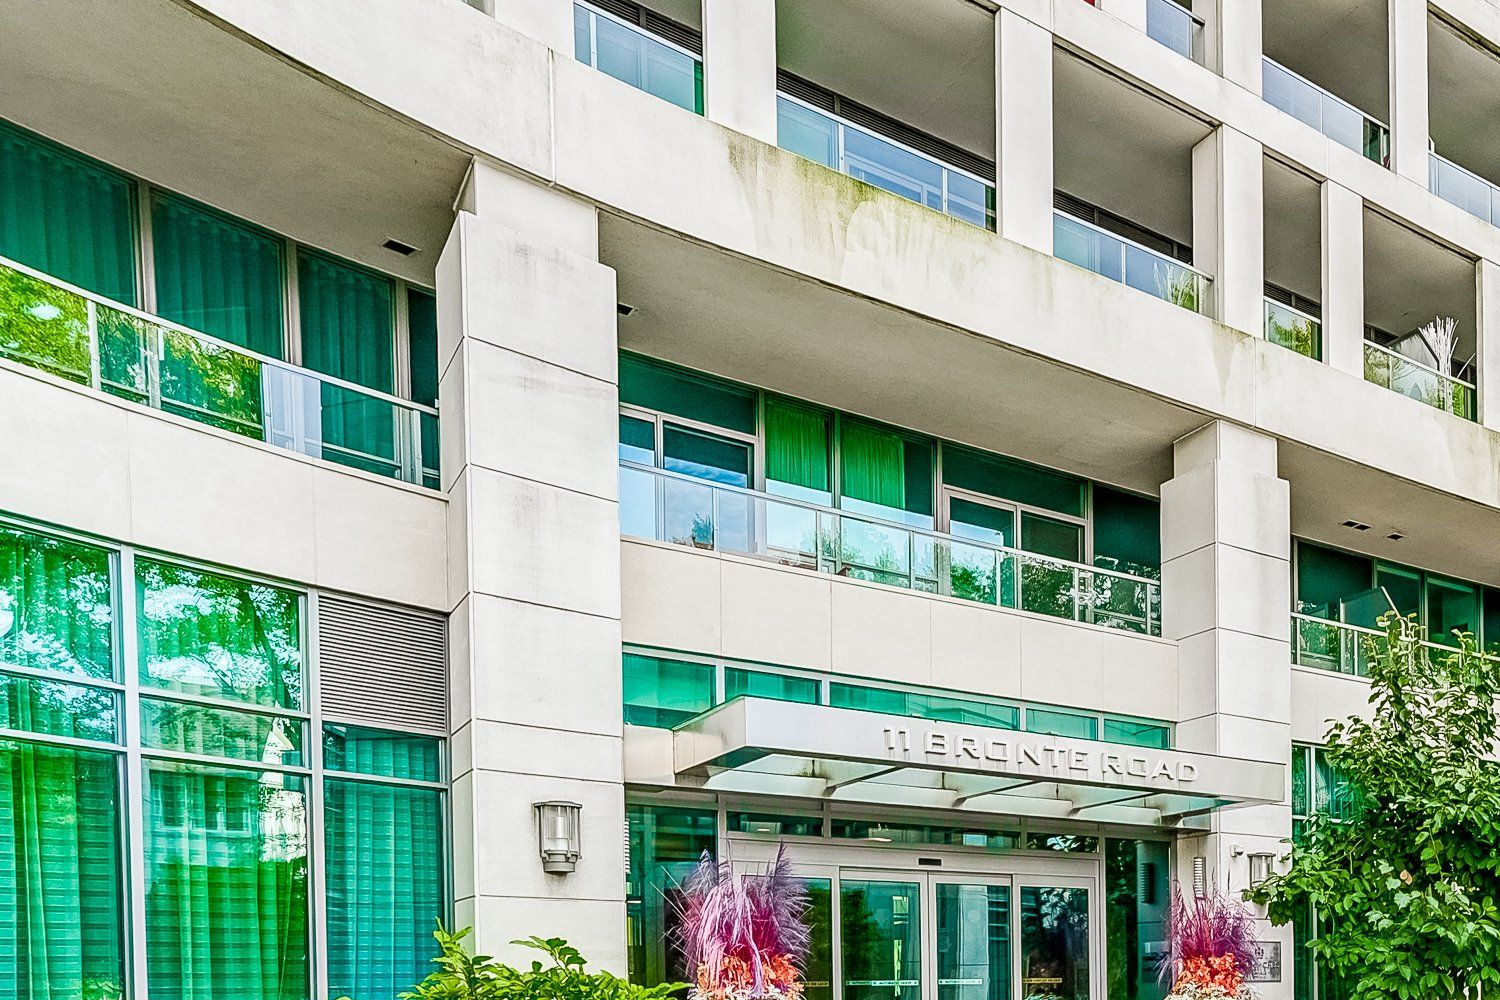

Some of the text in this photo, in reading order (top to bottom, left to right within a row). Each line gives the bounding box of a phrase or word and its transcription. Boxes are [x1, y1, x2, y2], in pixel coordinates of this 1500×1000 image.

[883, 727, 1200, 782] 11 BRONTE ROAD
